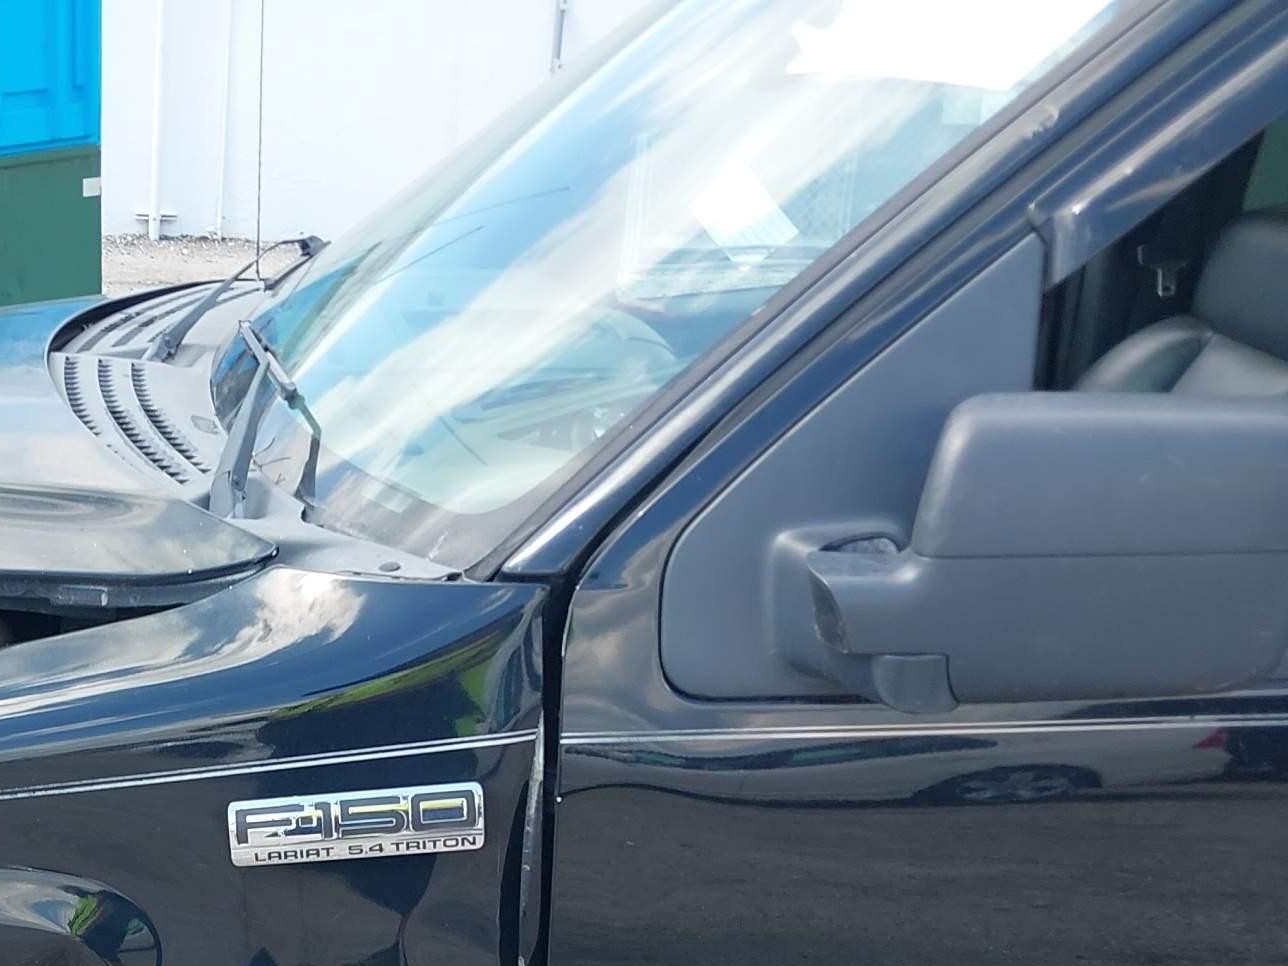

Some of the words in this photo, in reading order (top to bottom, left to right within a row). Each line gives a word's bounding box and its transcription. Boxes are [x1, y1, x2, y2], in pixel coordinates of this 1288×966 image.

[254, 847, 335, 862] LARIAT
[348, 843, 384, 856] 5.4
[390, 836, 477, 852] TRITON
